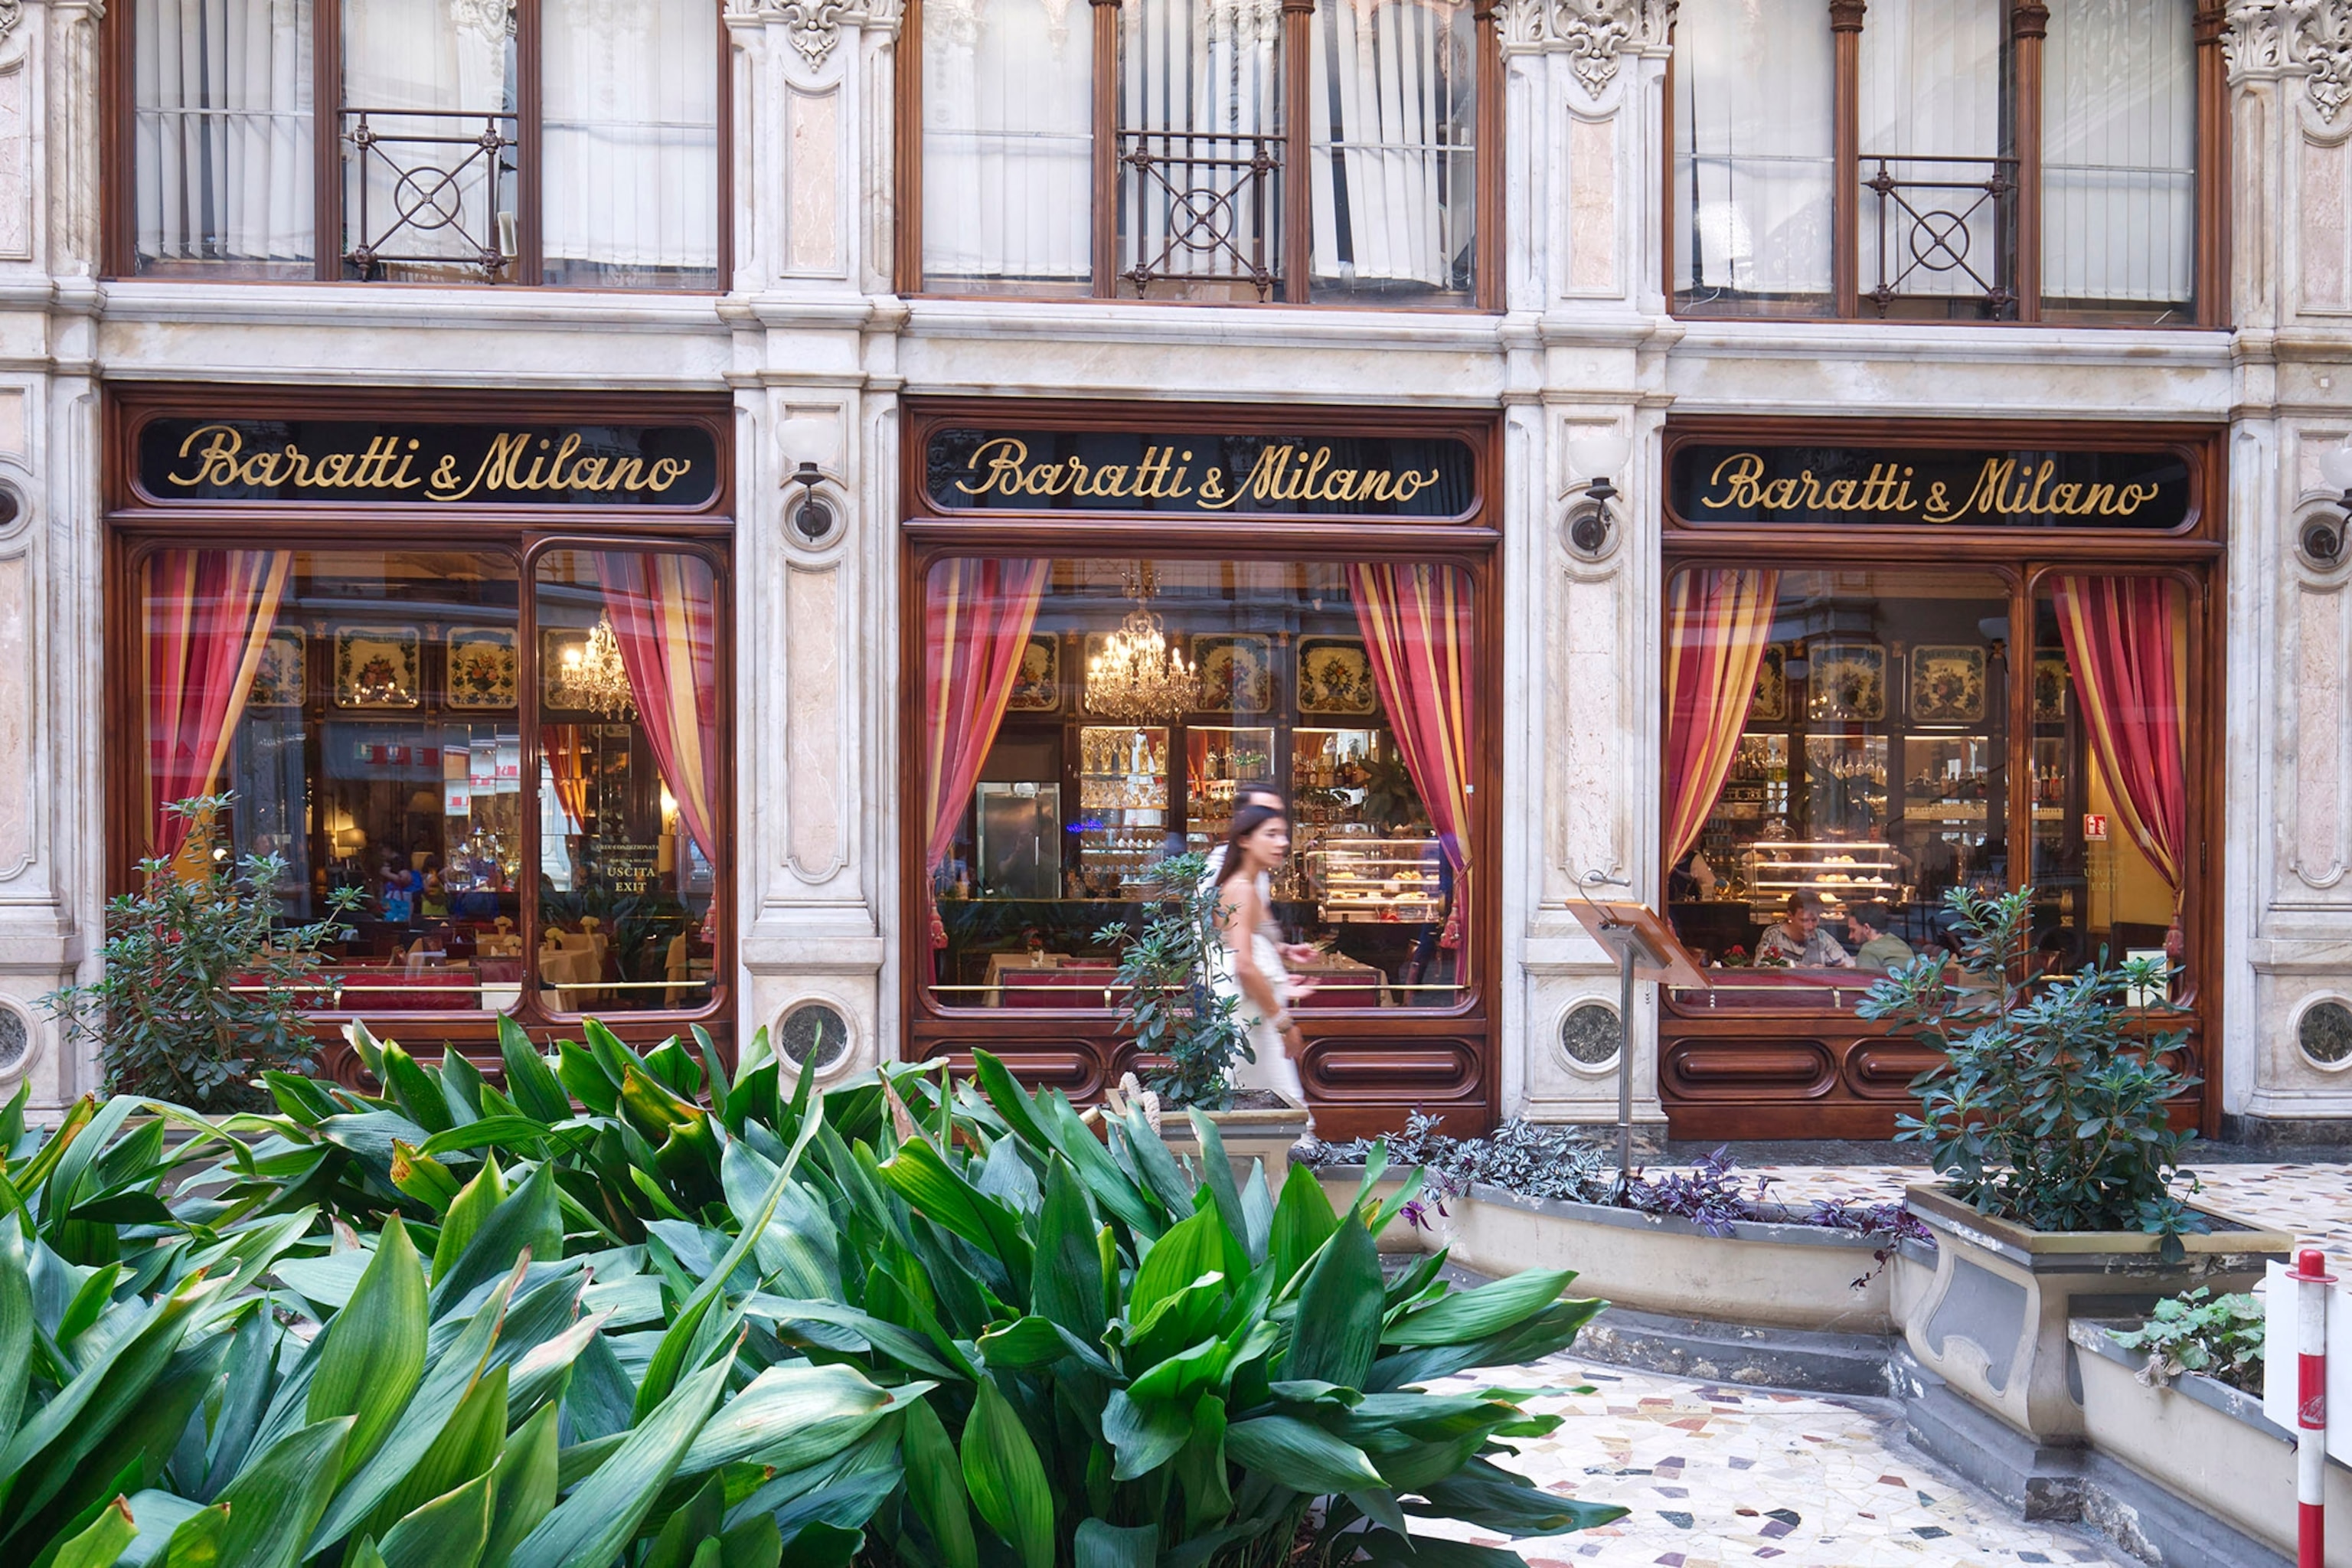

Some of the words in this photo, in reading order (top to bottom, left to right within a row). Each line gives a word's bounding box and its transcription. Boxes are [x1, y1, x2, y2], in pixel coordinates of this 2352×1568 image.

[168, 425, 420, 489] Baratti
[424, 433, 691, 501] Milano
[430, 454, 461, 489] &
[955, 438, 1192, 498] Baratti
[1197, 445, 1439, 509] Milano
[1199, 467, 1224, 499] &
[1701, 453, 1918, 511] Baratti
[1922, 459, 2159, 523] Milano
[1925, 482, 1950, 512] &
[607, 867, 656, 877] USCITA
[615, 881, 647, 892] EXIT
